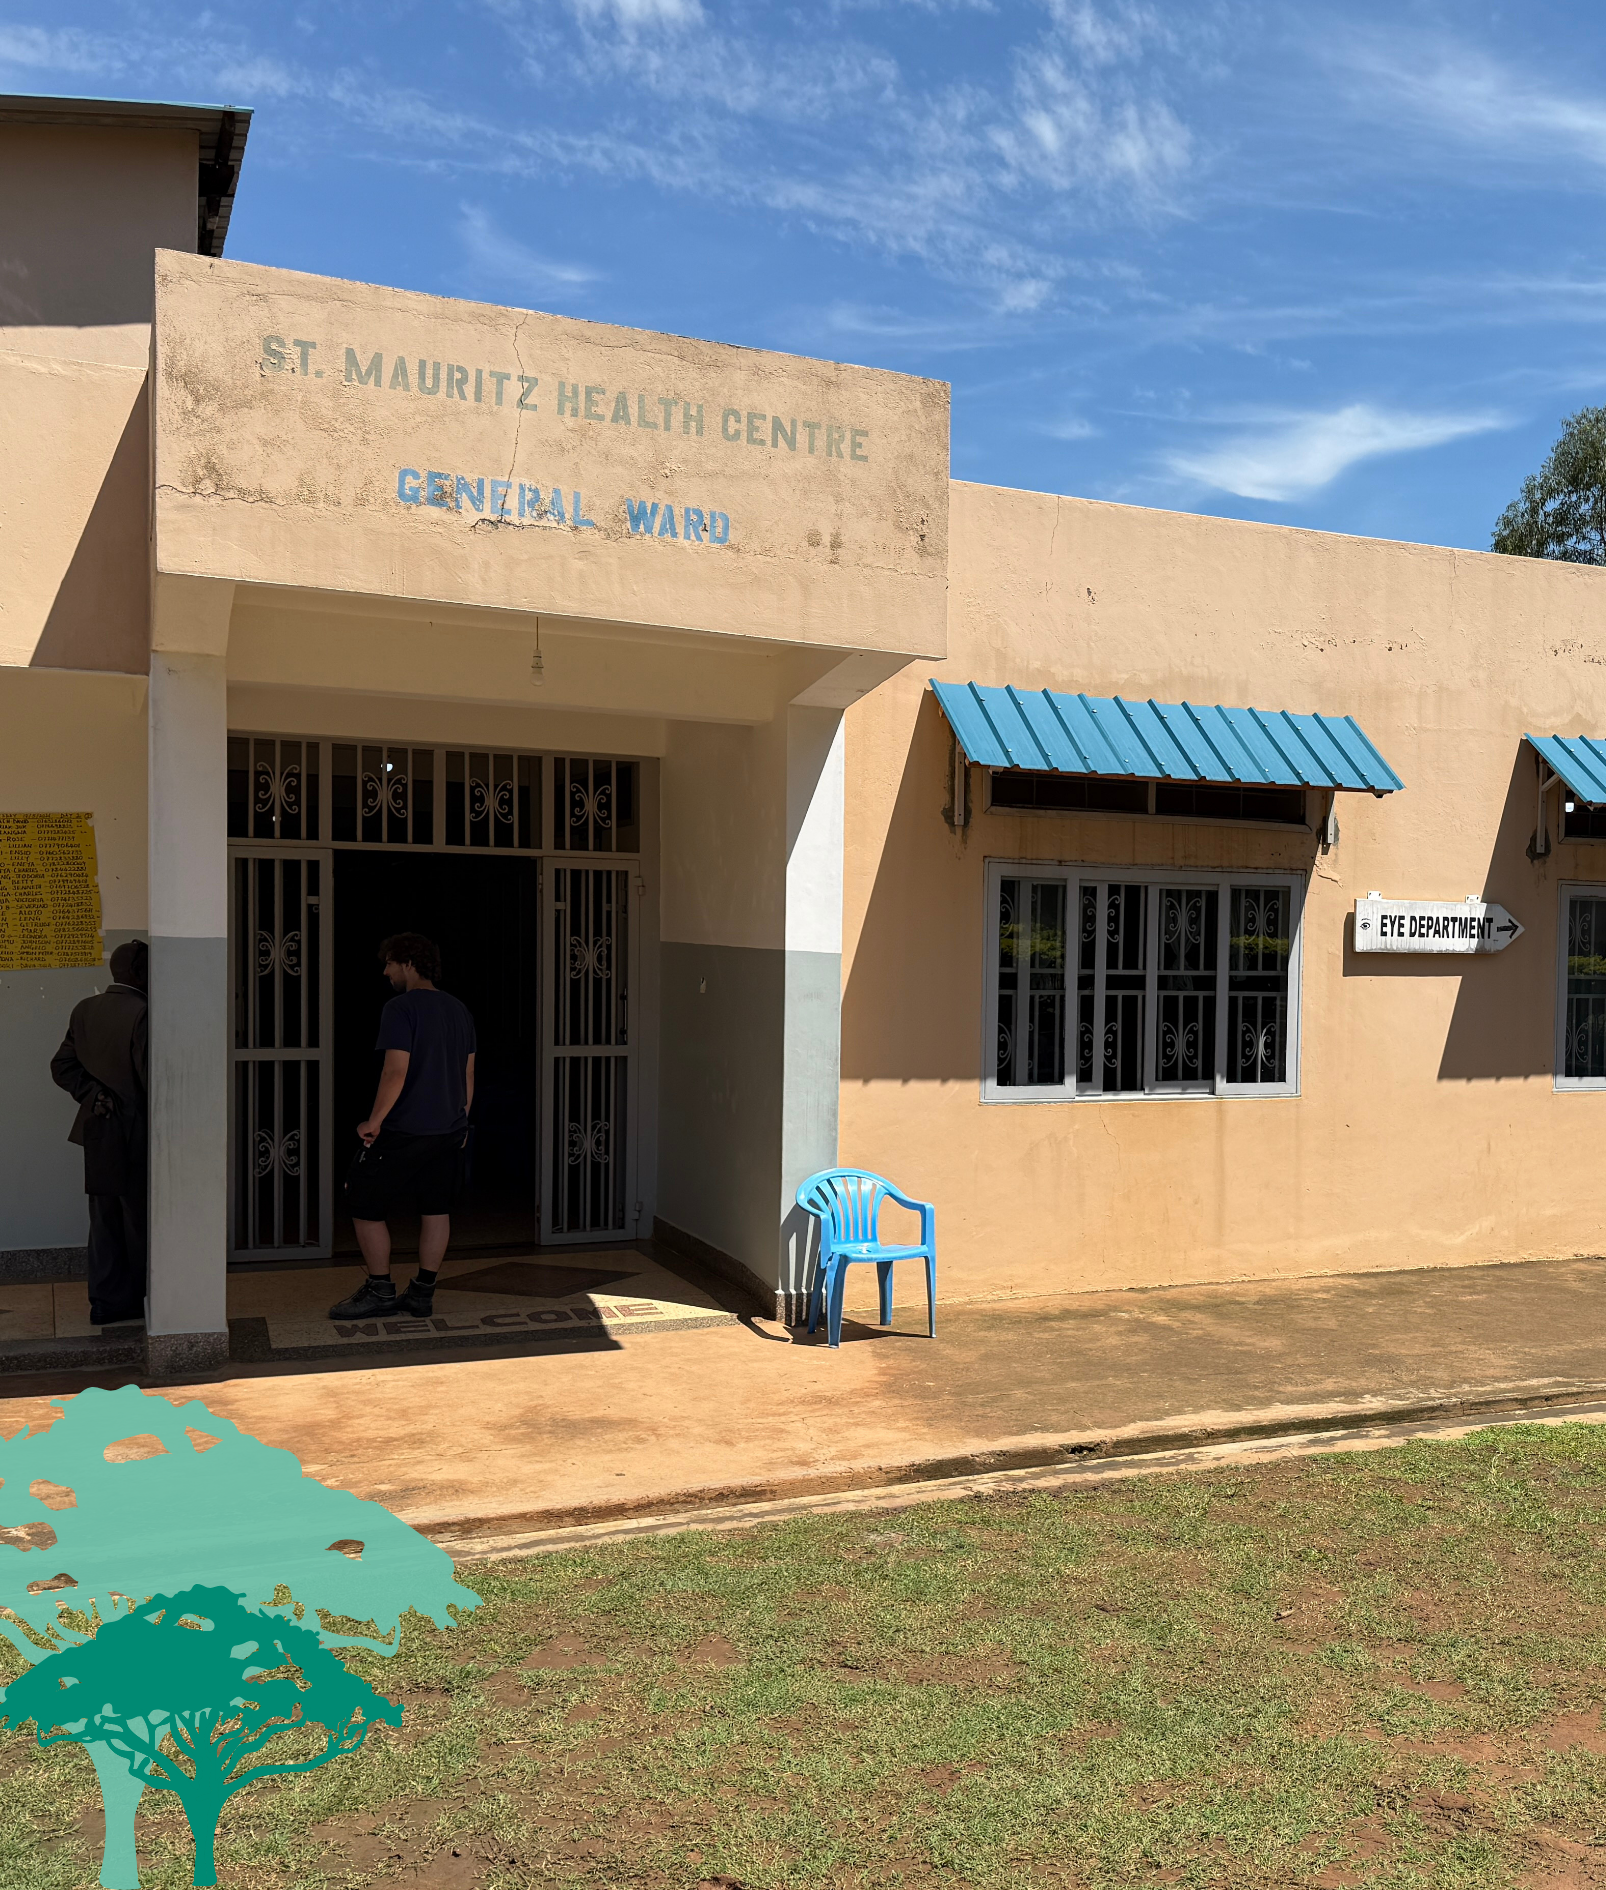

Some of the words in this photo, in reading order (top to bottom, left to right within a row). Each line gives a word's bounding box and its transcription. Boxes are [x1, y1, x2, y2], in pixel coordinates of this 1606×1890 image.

[262, 334, 324, 379] ST.
[344, 346, 539, 412] MAURITZ
[556, 380, 704, 437] HEALTH
[721, 407, 869, 462] CENTRE
[398, 467, 594, 527] GENERAL
[625, 497, 730, 545] WARD
[1380, 914, 1406, 938] EYE
[1408, 915, 1494, 939] DEPARTMENT
[334, 1302, 664, 1338] WELCOME
